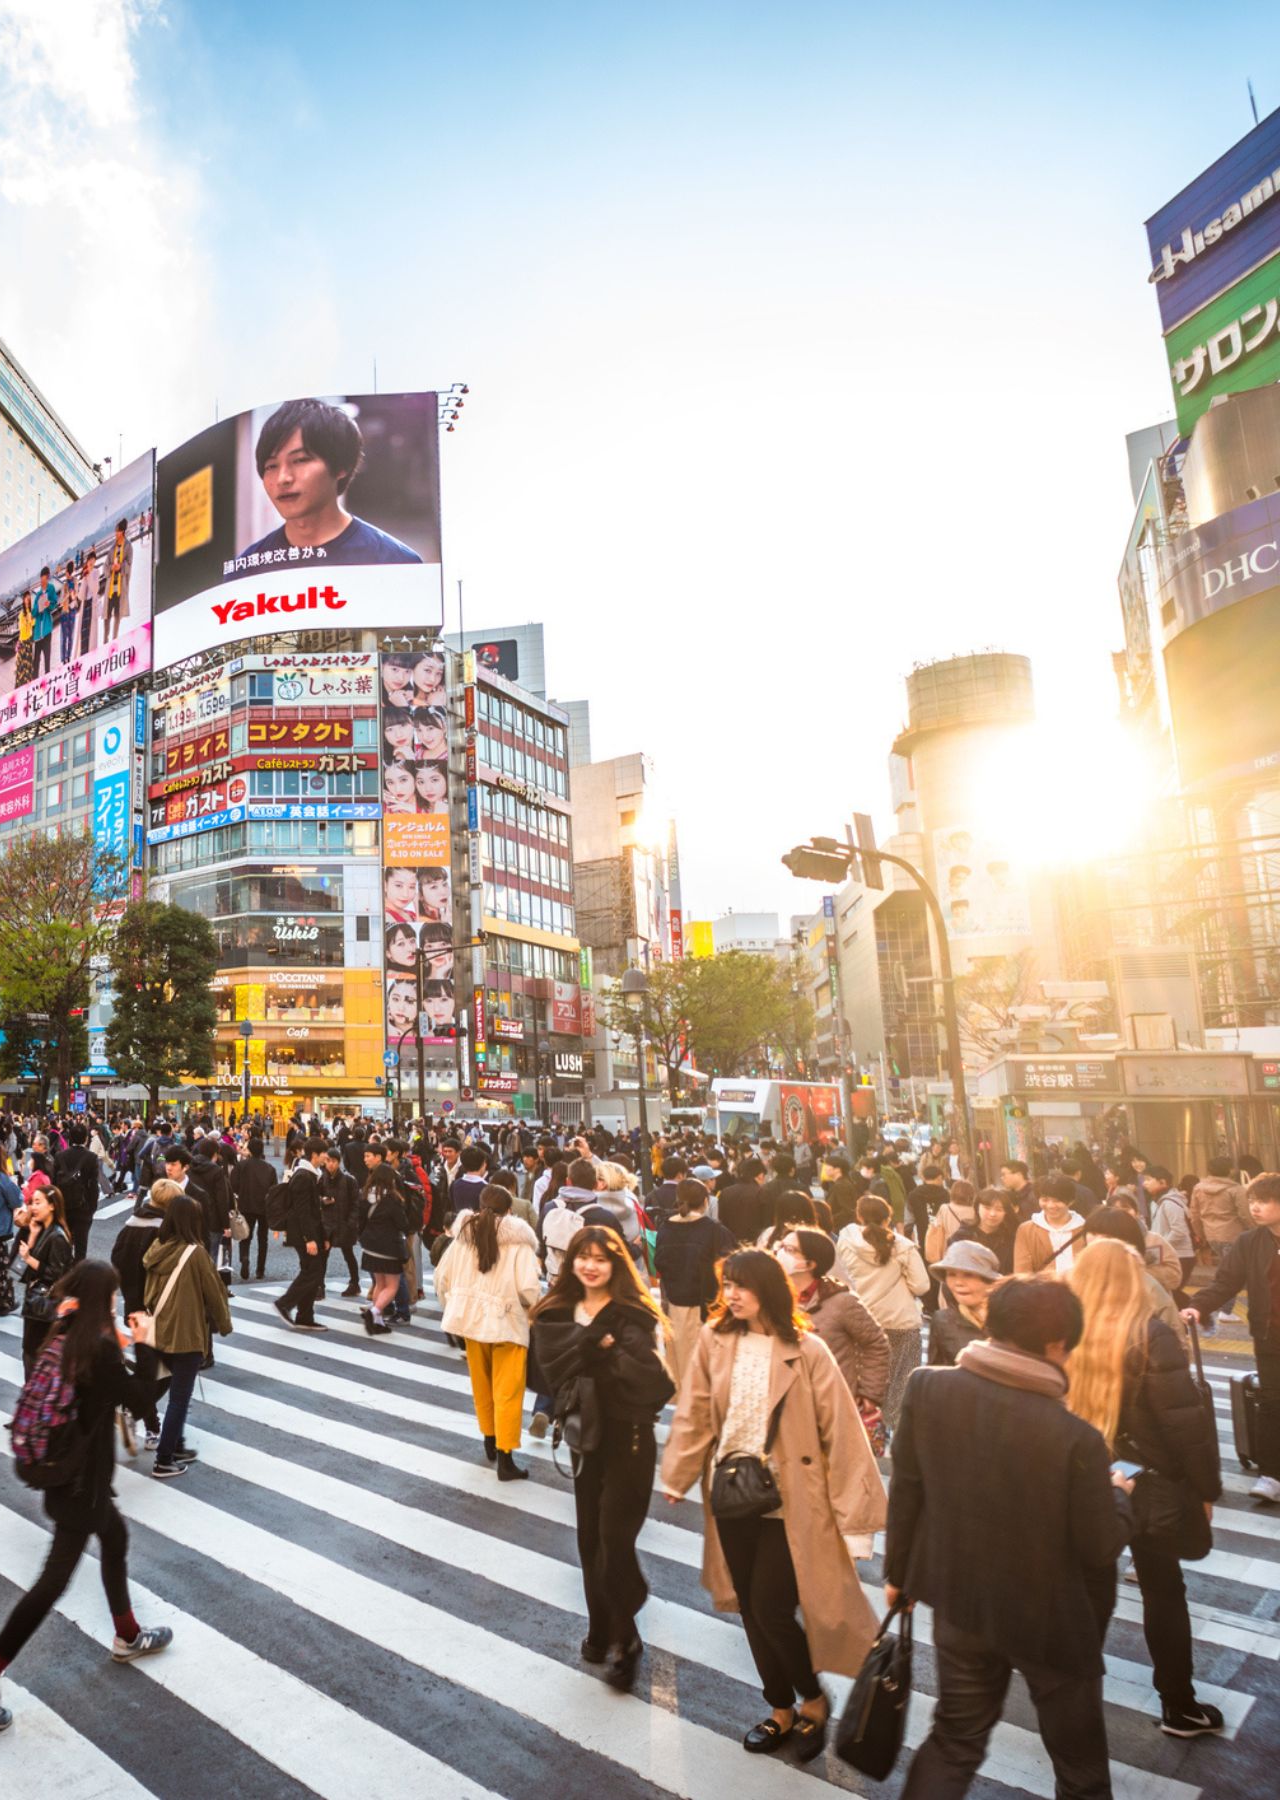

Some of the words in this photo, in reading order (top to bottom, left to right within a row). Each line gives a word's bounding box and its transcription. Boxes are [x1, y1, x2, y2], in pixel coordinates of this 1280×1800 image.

[1171, 297, 1280, 397] サロン
[1201, 540, 1280, 600] DHC
[210, 585, 348, 625] Yakult
[262, 655, 371, 667] しゃぶしゃぶバイキング
[309, 675, 372, 696] しゃぶ葉
[153, 716, 166, 730] 9F
[249, 722, 350, 742] コンタクト
[167, 732, 228, 768] プライス
[319, 755, 366, 772] ガスト
[200, 761, 233, 786] ガスト
[185, 790, 224, 819] ガスト
[289, 805, 380, 818] 英会話イーオン
[151, 807, 166, 823] 7F
[410, 850, 422, 858] ON
[272, 926, 320, 940] Ushi8
[269, 972, 326, 983] L'OCCITANE
[286, 1027, 310, 1037] Café
[555, 1053, 583, 1073] LUSH
[1024, 1072, 1074, 1088] 渋谷駅
